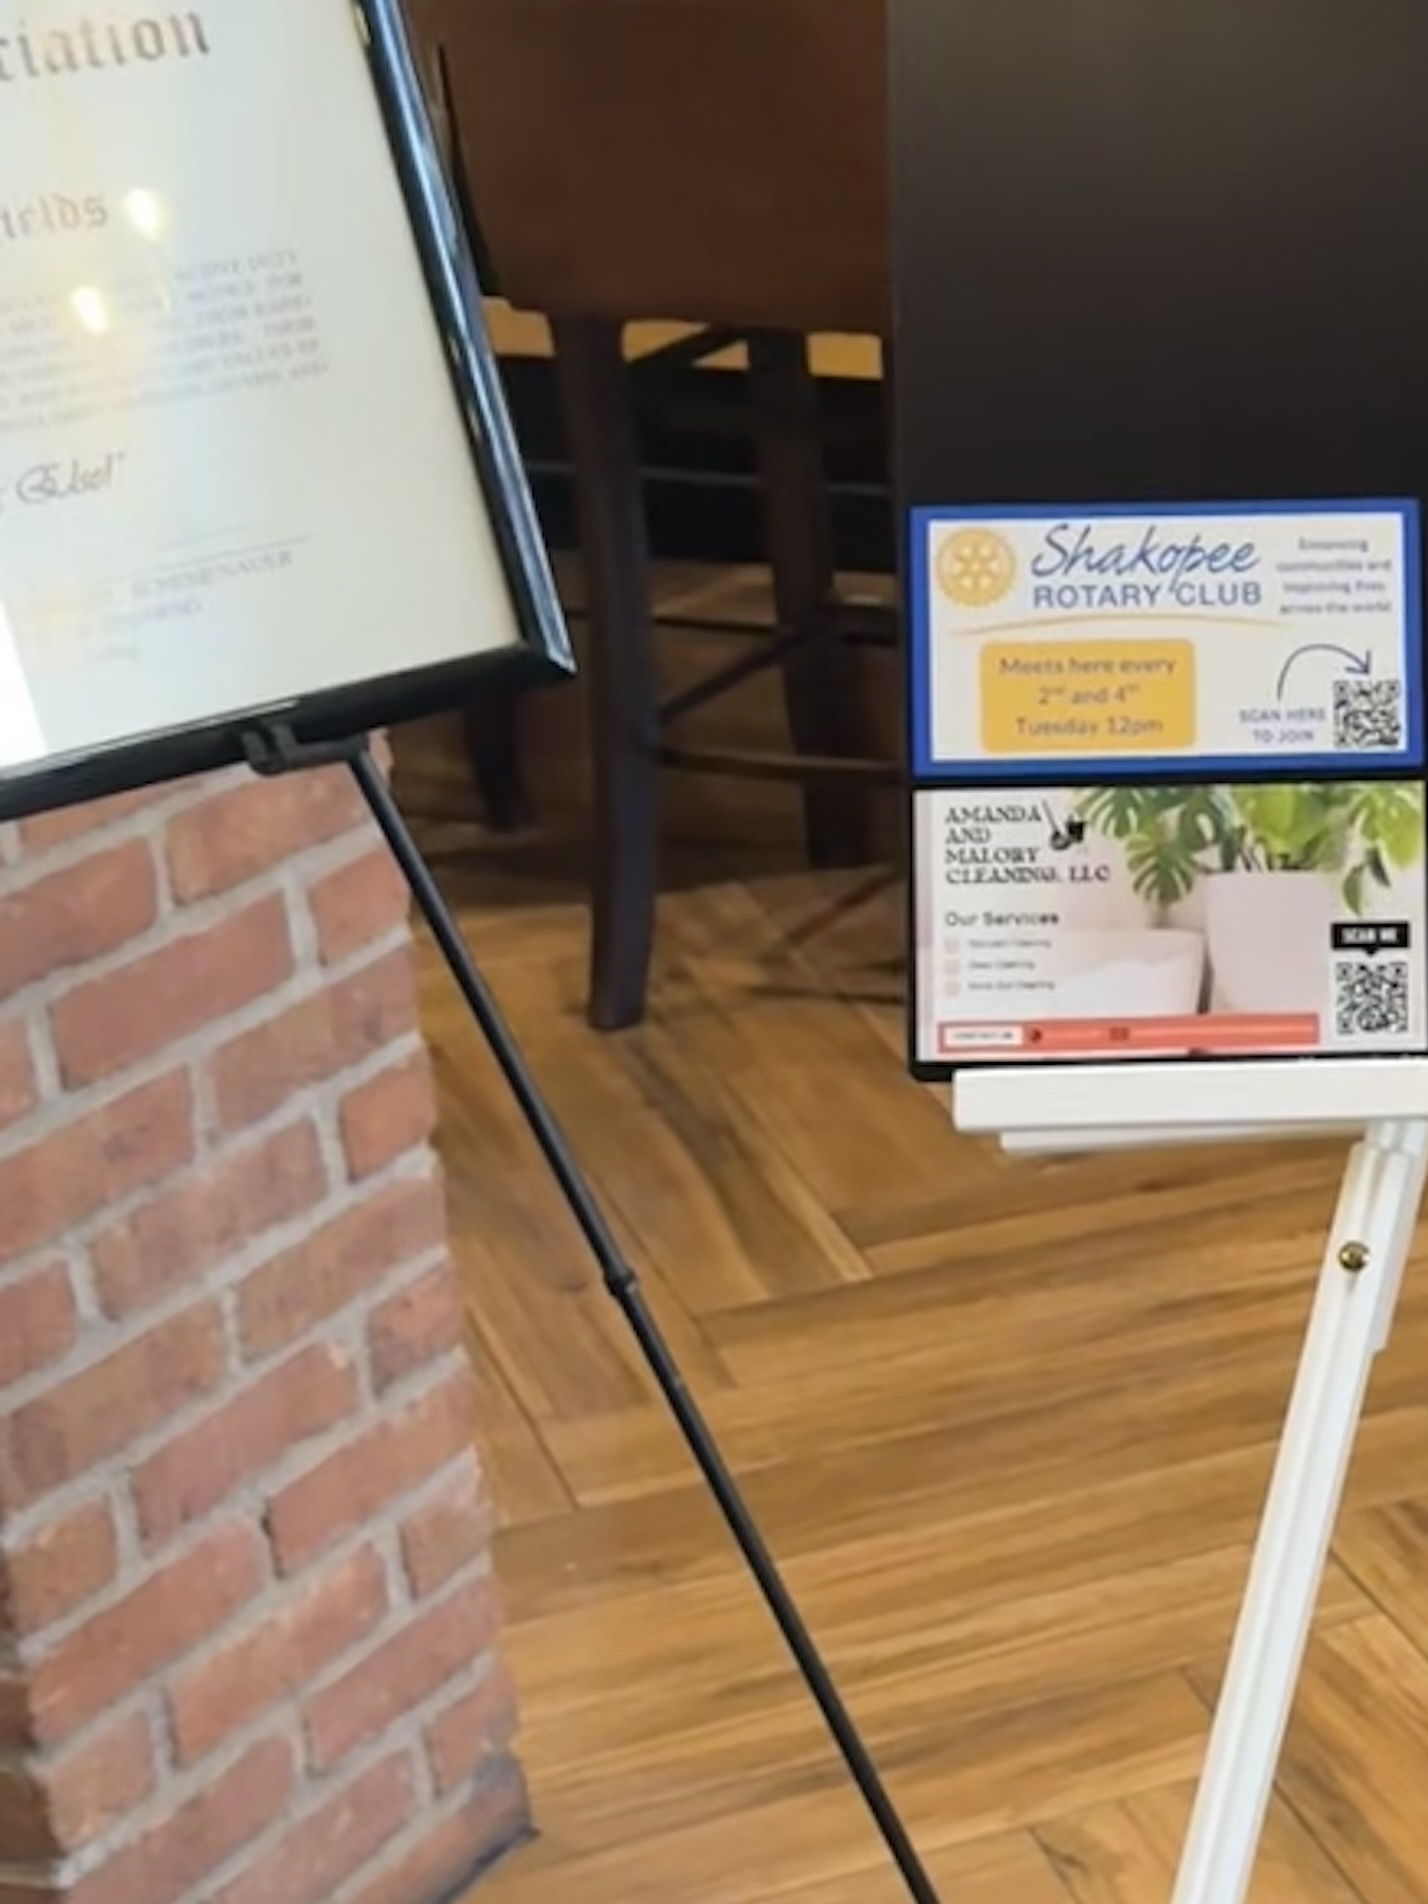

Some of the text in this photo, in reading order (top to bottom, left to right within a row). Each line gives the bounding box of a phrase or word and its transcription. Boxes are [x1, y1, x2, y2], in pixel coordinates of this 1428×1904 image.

[1031, 522, 1261, 593] Shakopee
[1033, 581, 1263, 609] ROTARY CLUB
[1000, 657, 1176, 676] Meets here every
[1070, 687, 1109, 705] and
[1239, 707, 1326, 723] SCAN HERE
[1016, 716, 1164, 737] Tuesday 12pm
[1252, 728, 1315, 744] TO JOIN
[945, 806, 1042, 824] AMANDA
[945, 826, 991, 845] AND
[1069, 865, 1111, 882] LLC
[945, 910, 1060, 927] Our Services
